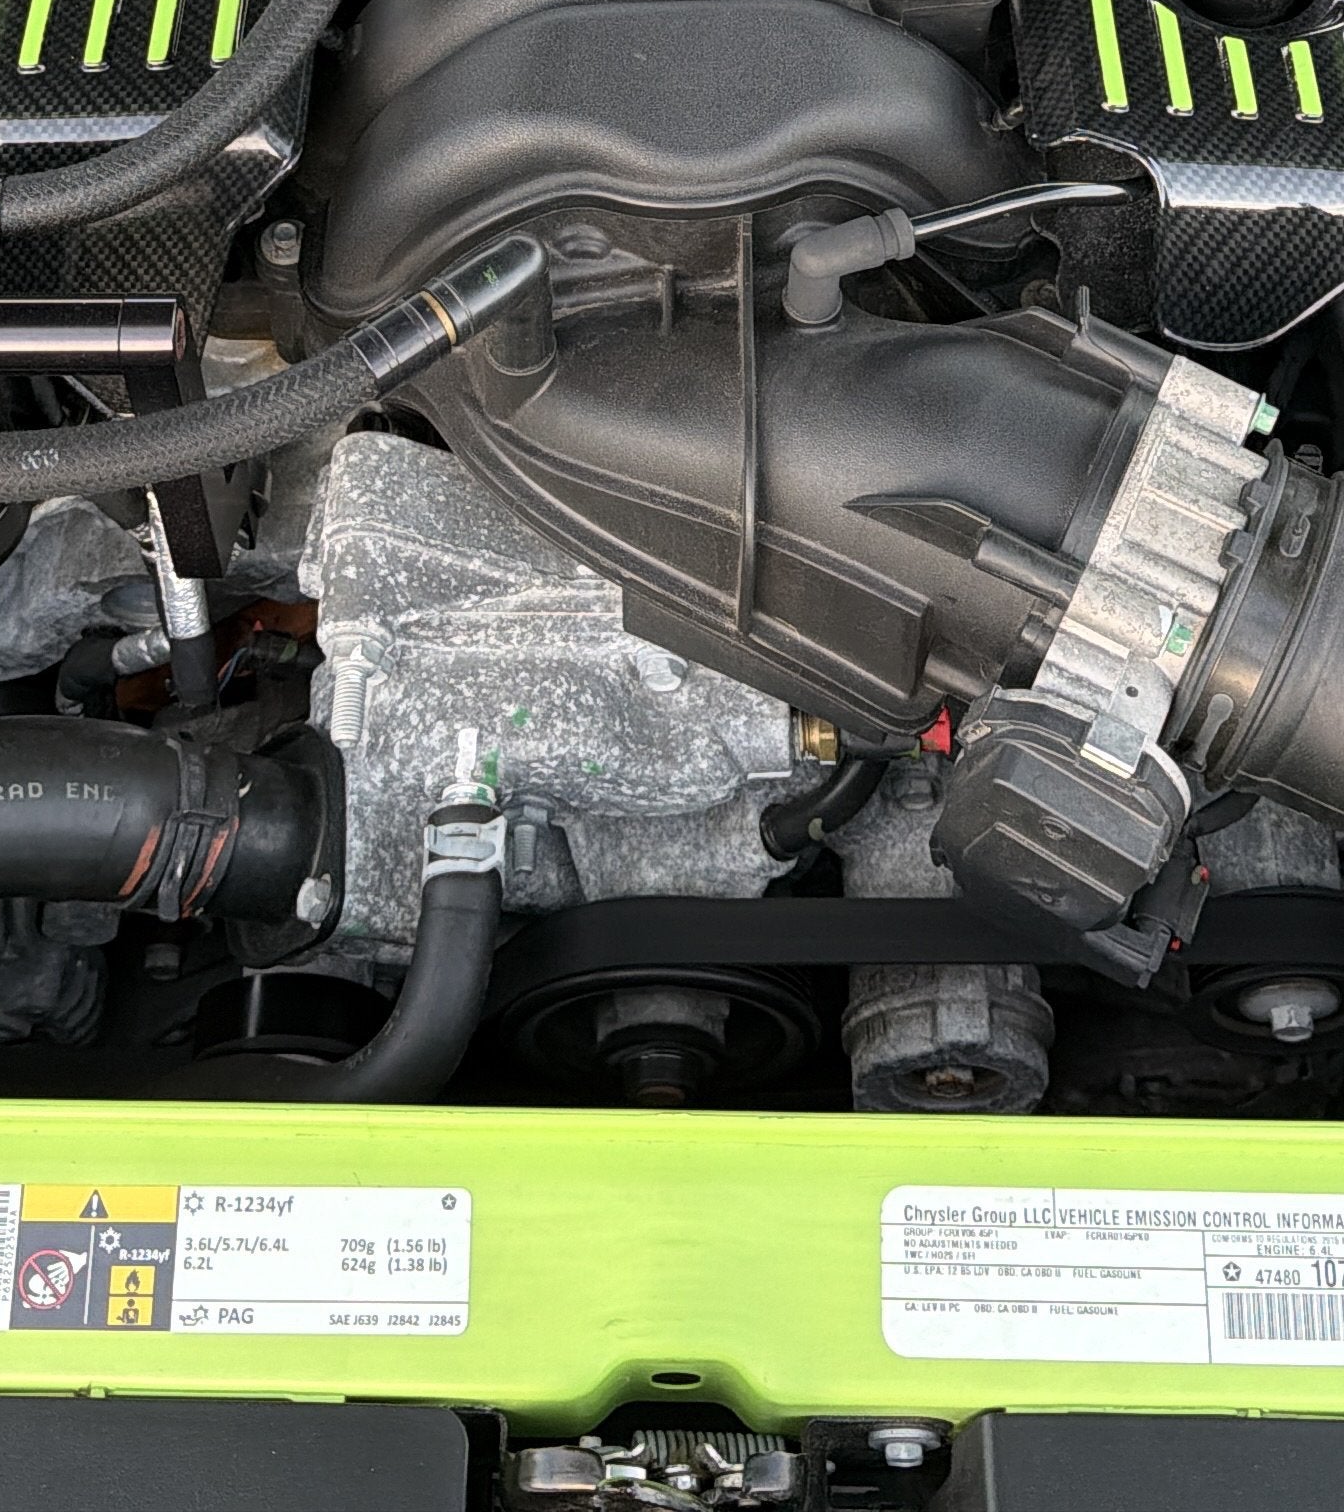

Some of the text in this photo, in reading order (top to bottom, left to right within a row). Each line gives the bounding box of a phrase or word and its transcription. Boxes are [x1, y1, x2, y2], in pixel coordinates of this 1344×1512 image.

[215, 1195, 295, 1217] R-1234yf
[904, 1204, 1051, 1227] Chrysler Group LLC
[1059, 1208, 1120, 1226] VEHICLE
[1126, 1209, 1197, 1227] EMISSION
[1203, 1210, 1271, 1229] CONTROL
[184, 1236, 289, 1254] 3.6L/5.7L/6.4L
[340, 1238, 446, 1256] 709g (1.56 lb)
[919, 1240, 981, 1250] ADJUSTMENTS
[983, 1241, 1018, 1251] NEEDED
[1257, 1244, 1334, 1256] ENGINE: 6.4L
[1, 1210, 18, 1302] P68250256AA
[119, 1248, 170, 1264] R-1234yf
[184, 1257, 213, 1270] 6.2L
[341, 1257, 447, 1276] 624g (1.38 lb)
[1035, 1268, 1052, 1278] OBD
[1099, 1268, 1142, 1280] GASOLINE
[1255, 1269, 1301, 1286] 47480
[218, 1307, 254, 1325] PAG
[997, 1304, 1010, 1315] CA
[1011, 1304, 1030, 1315] OBD
[1076, 1305, 1119, 1317] GASOLINE
[328, 1314, 461, 1328] SAE J639 J2842 J2845
